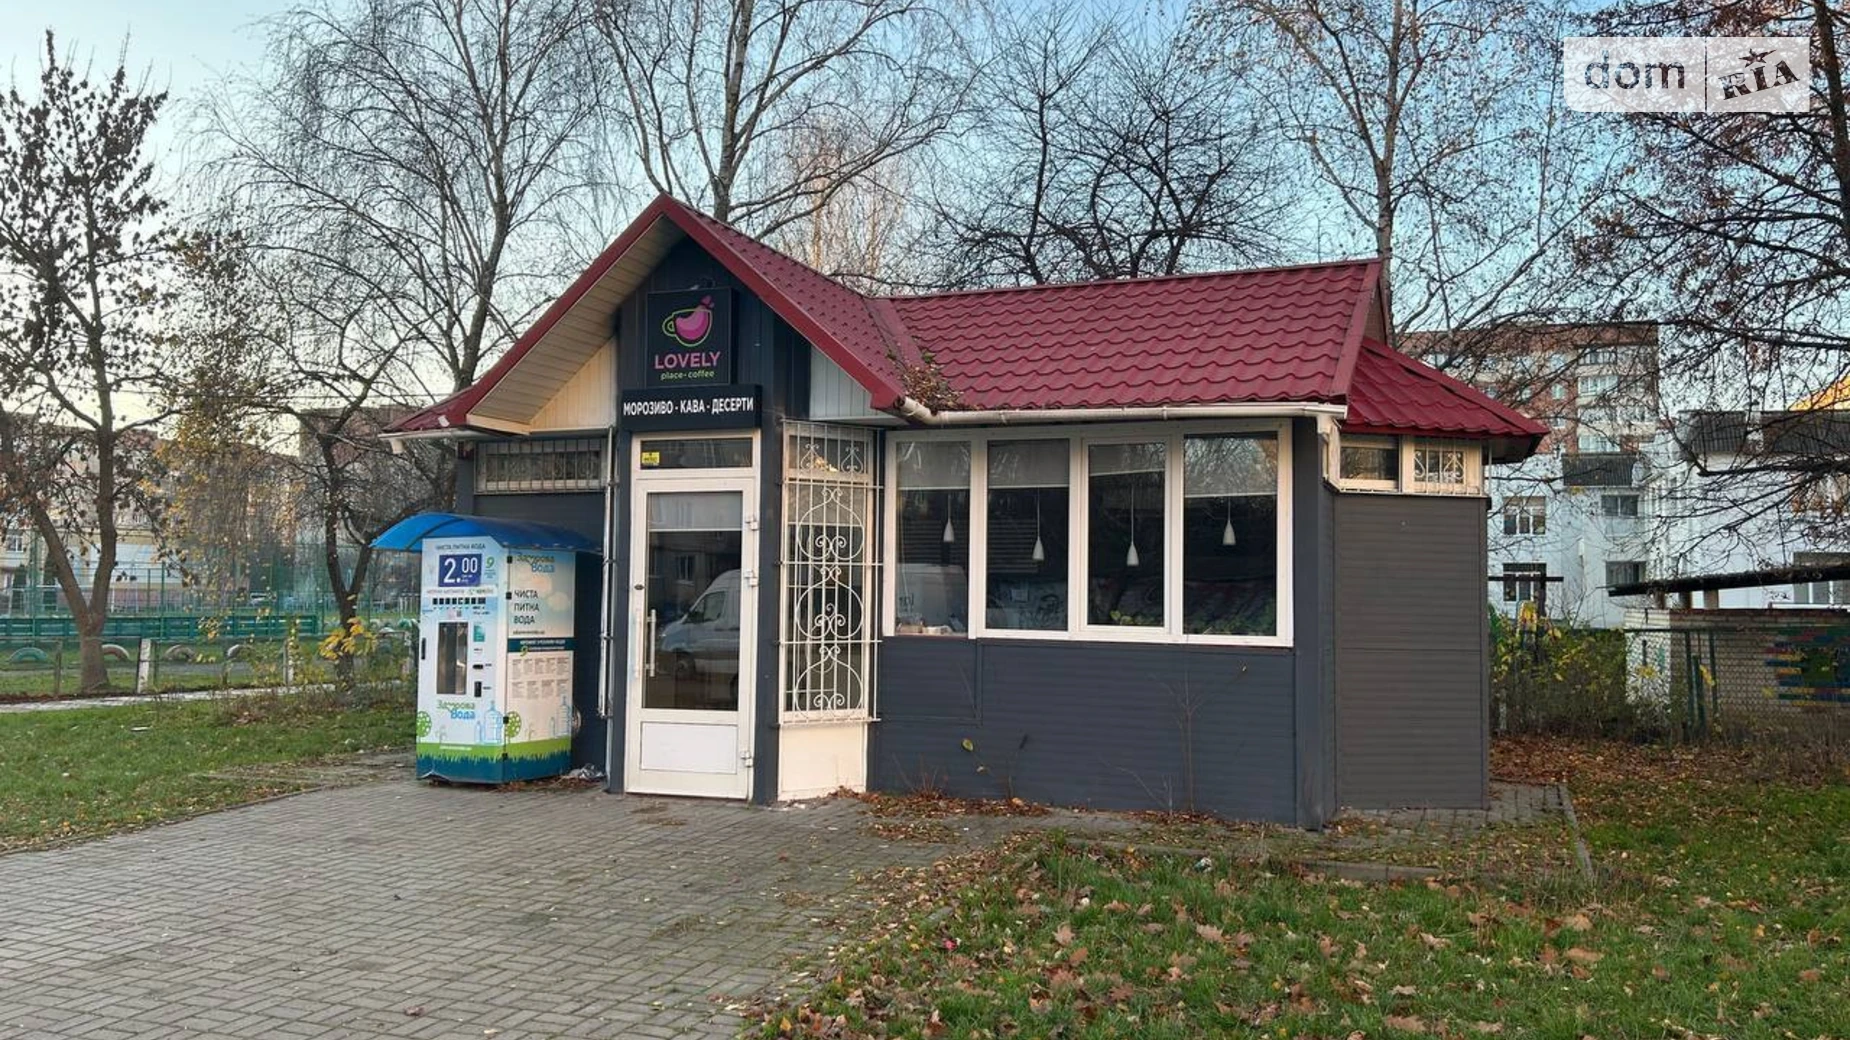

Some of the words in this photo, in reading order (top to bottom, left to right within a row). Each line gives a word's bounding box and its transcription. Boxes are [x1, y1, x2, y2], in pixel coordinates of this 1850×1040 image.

[654, 351, 721, 370] LOVELY
[623, 400, 673, 416] МОРОЗИВО
[680, 398, 705, 414] КАВА
[711, 397, 754, 415] ДЕСЕРТИ
[514, 589, 539, 598] ЧИСТА
[514, 603, 540, 612] ПИТНА
[513, 615, 535, 625] ВОДА
[450, 708, 476, 719] Вода
